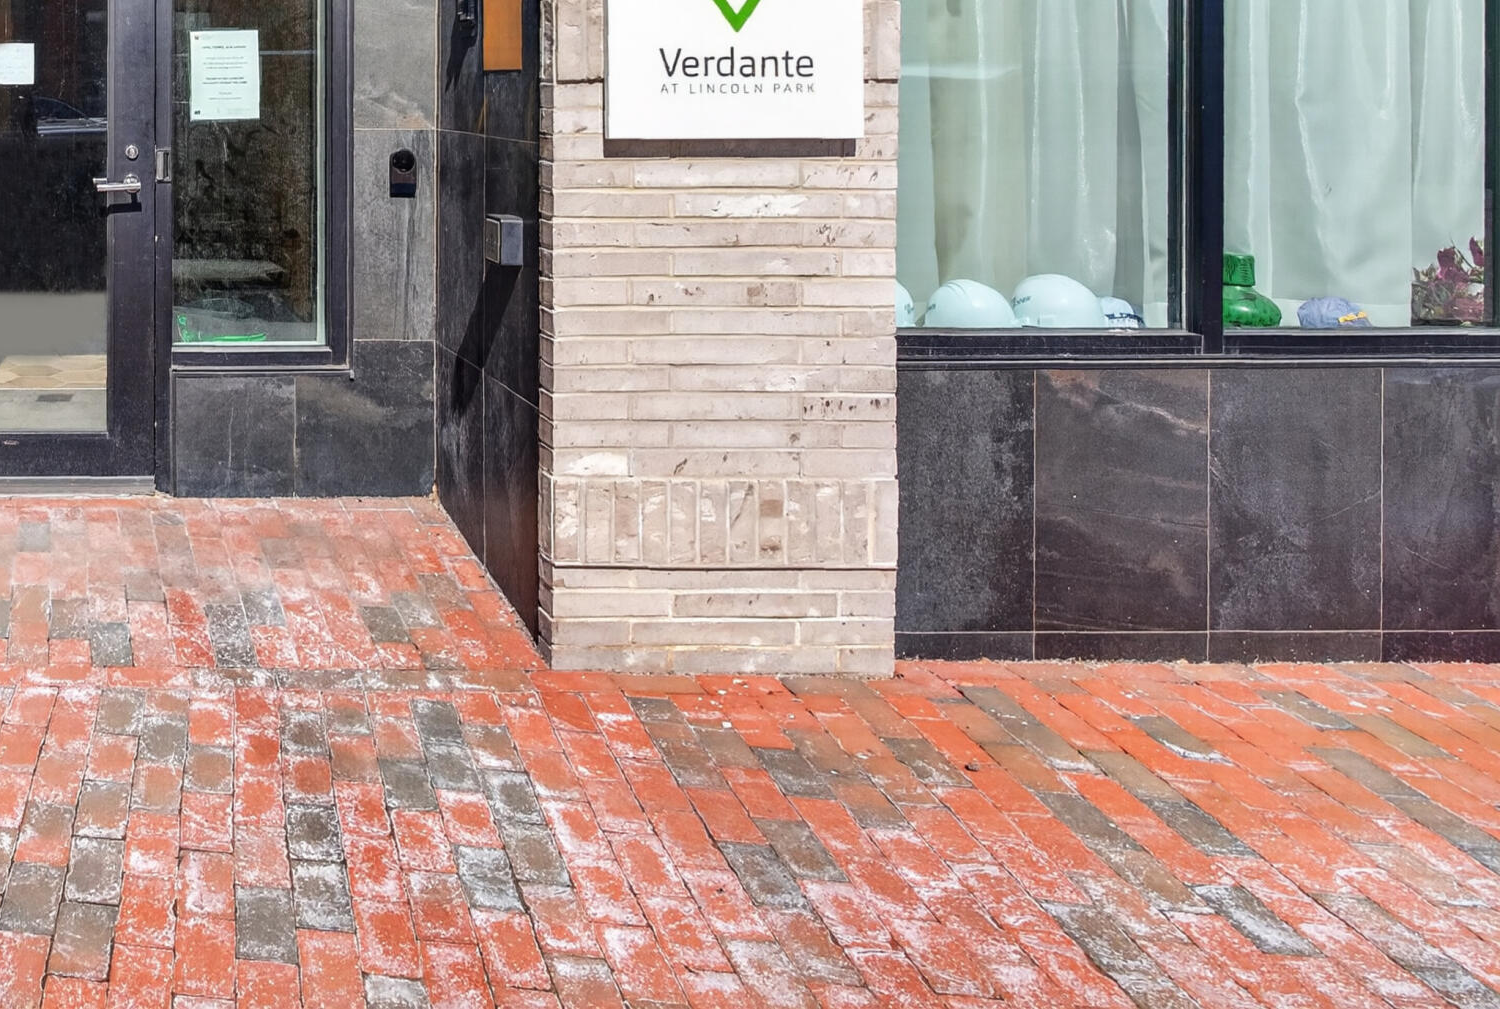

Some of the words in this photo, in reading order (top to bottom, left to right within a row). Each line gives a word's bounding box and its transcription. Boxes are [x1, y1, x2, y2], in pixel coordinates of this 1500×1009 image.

[659, 46, 814, 78] Verdante
[660, 83, 680, 94] AT
[689, 83, 763, 94] LINCOLN
[773, 83, 815, 94] PARK
